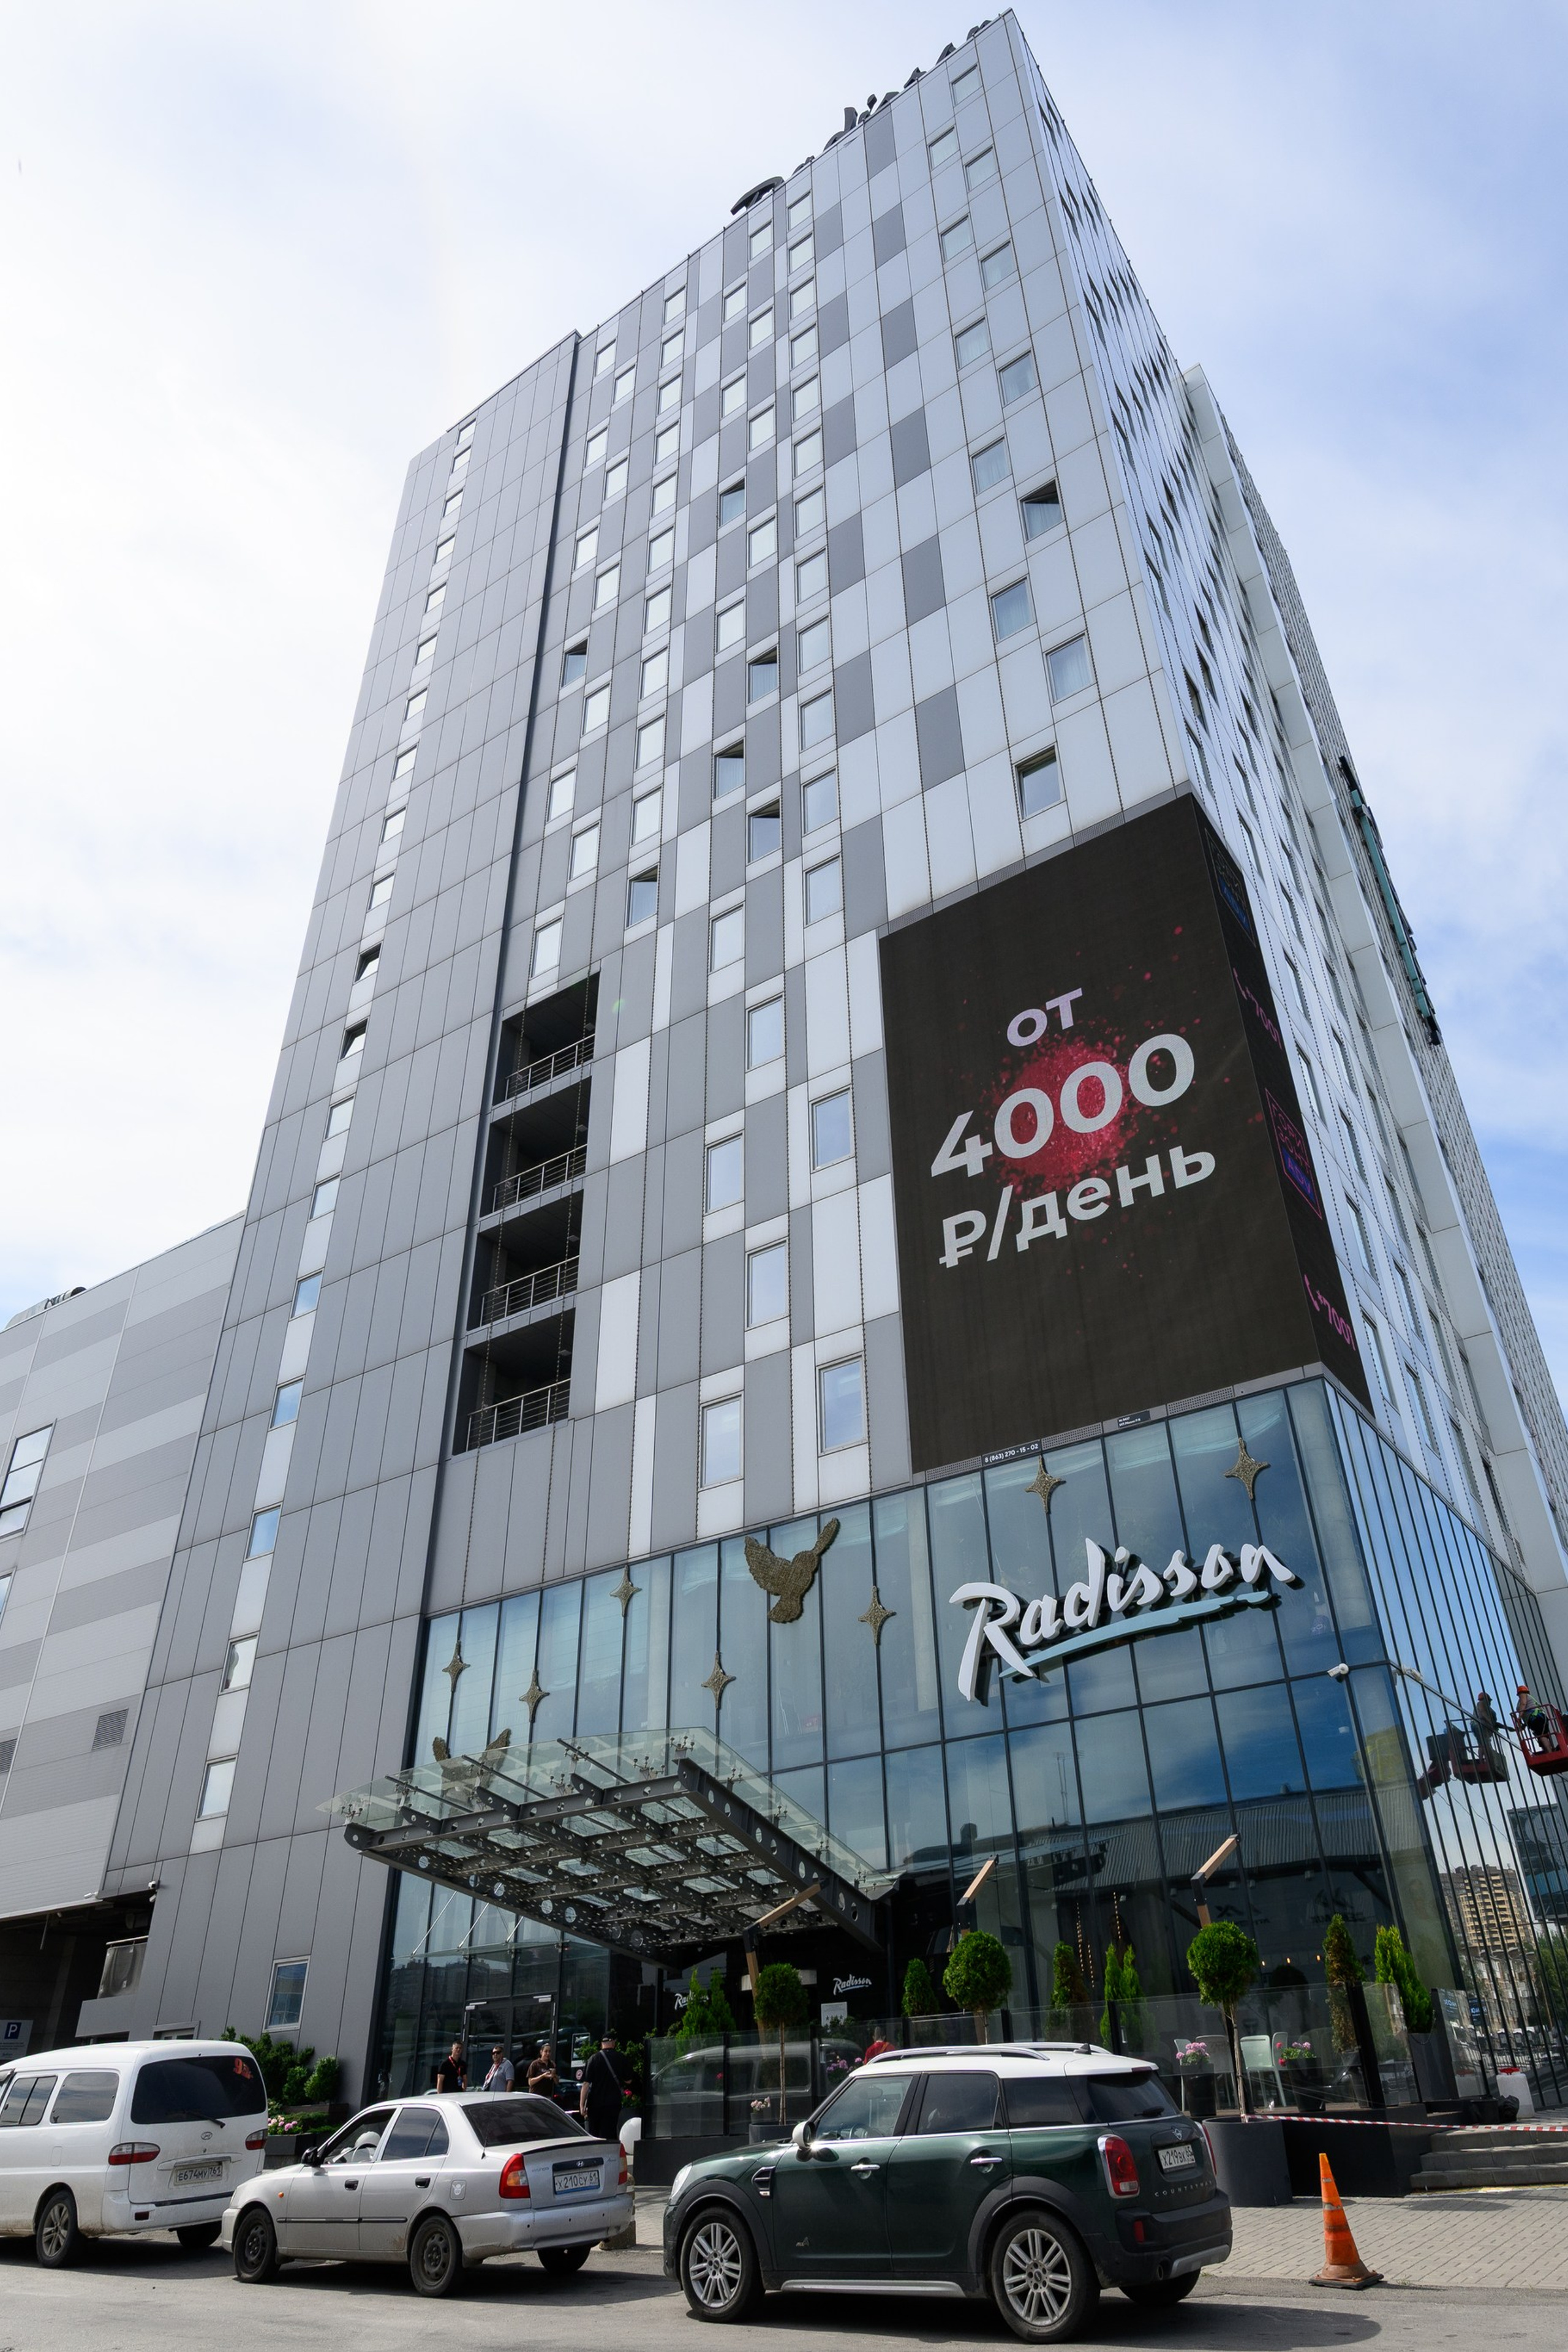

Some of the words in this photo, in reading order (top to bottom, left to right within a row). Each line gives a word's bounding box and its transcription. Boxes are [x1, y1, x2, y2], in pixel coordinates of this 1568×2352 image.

[930, 1033, 1195, 1177] 4000
[989, 1453, 1005, 1463] (863)
[949, 1537, 1296, 1702] Radisson
[833, 1973, 872, 1996] Radisson
